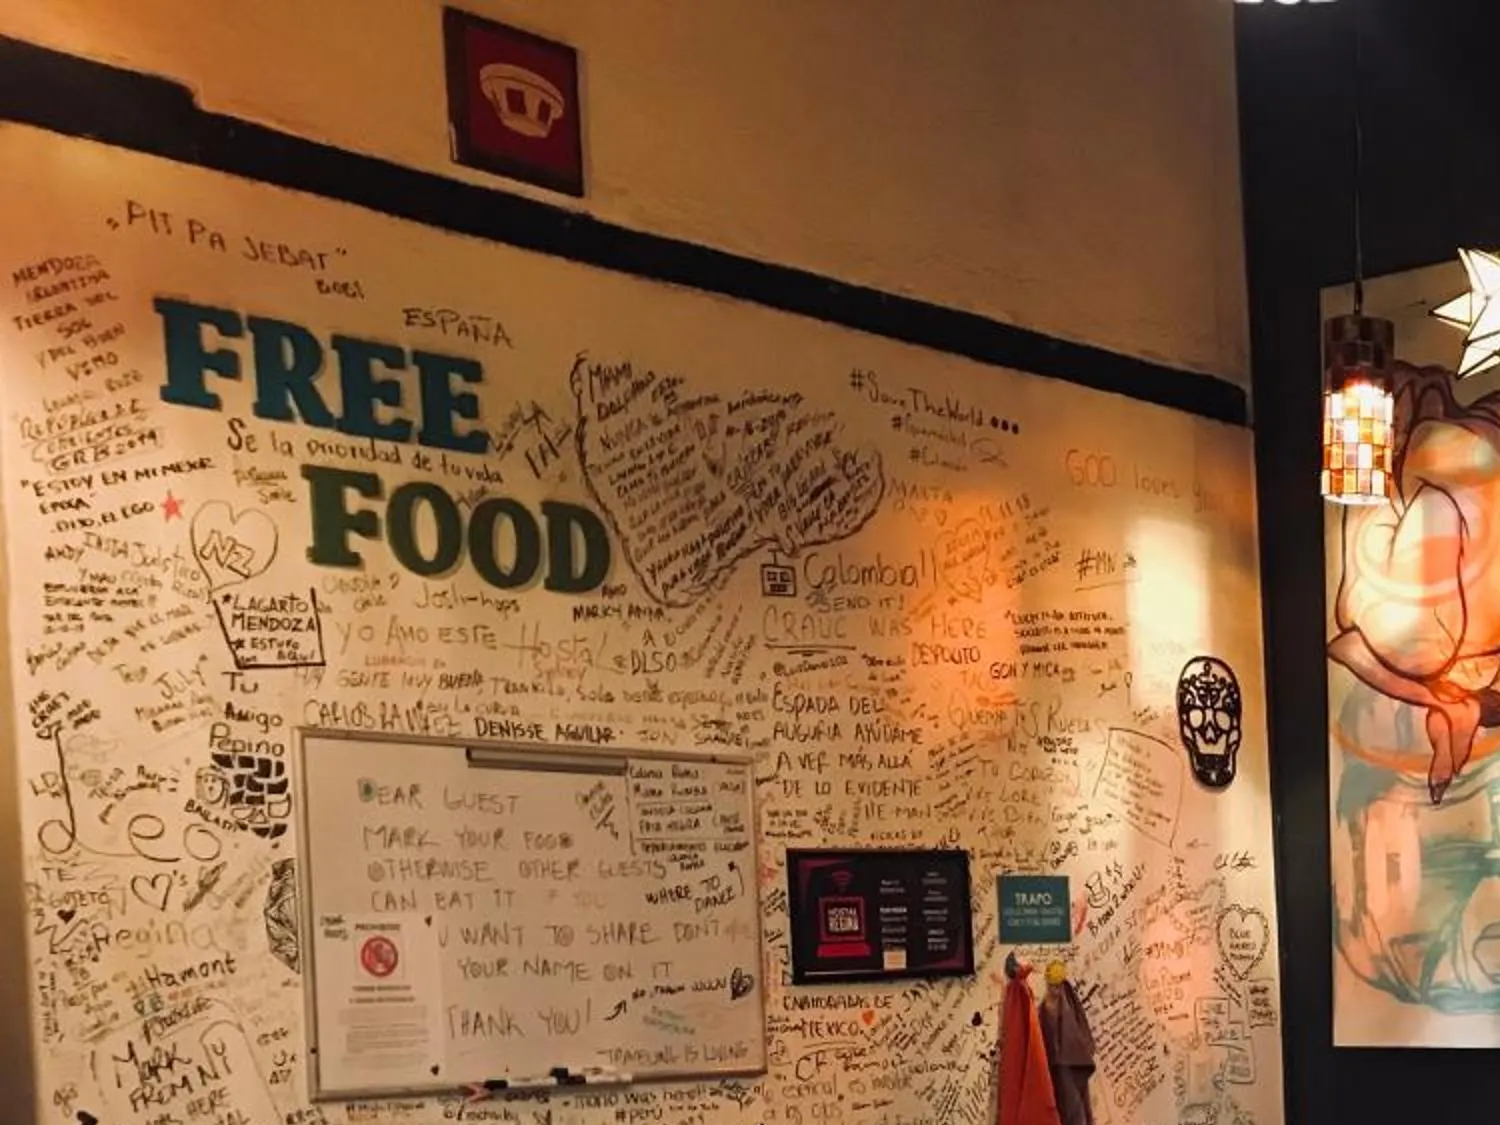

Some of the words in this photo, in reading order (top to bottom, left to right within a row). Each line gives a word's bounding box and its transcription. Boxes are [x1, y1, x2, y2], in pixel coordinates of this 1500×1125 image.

[188, 218, 226, 251] PA
[402, 308, 516, 350] ESPAÑA
[153, 296, 491, 455] FREE
[227, 417, 258, 453] Se
[272, 431, 294, 457] la
[412, 448, 433, 473] de
[300, 463, 612, 595] FOOD
[200, 529, 255, 579] NZ
[232, 611, 316, 633] MENDOZA
[868, 616, 913, 638] WAS
[930, 612, 987, 639] HERE
[336, 620, 375, 656] YO
[437, 624, 497, 650] ESTE
[220, 671, 259, 694] Tu
[224, 701, 284, 733] Amigo
[209, 722, 285, 758] Pepino
[776, 751, 792, 772] A
[443, 788, 520, 815] GUEST
[362, 824, 445, 851] MARK
[454, 829, 515, 851] YOUR
[367, 858, 494, 883] OTHERWISE
[518, 859, 581, 880] OTHER
[370, 887, 417, 912] CAN
[435, 887, 476, 909] EAT
[492, 887, 517, 909] IT
[643, 887, 693, 905] WHERE
[437, 929, 449, 948] U
[459, 923, 526, 947] WANT
[550, 923, 576, 947] TO
[587, 919, 663, 946] SHARE
[457, 957, 510, 980] YOUR
[522, 959, 592, 982] NAME
[603, 961, 634, 982] ON
[651, 961, 675, 978] IT
[448, 1006, 529, 1040] THANK
[540, 998, 593, 1034] YOU!
